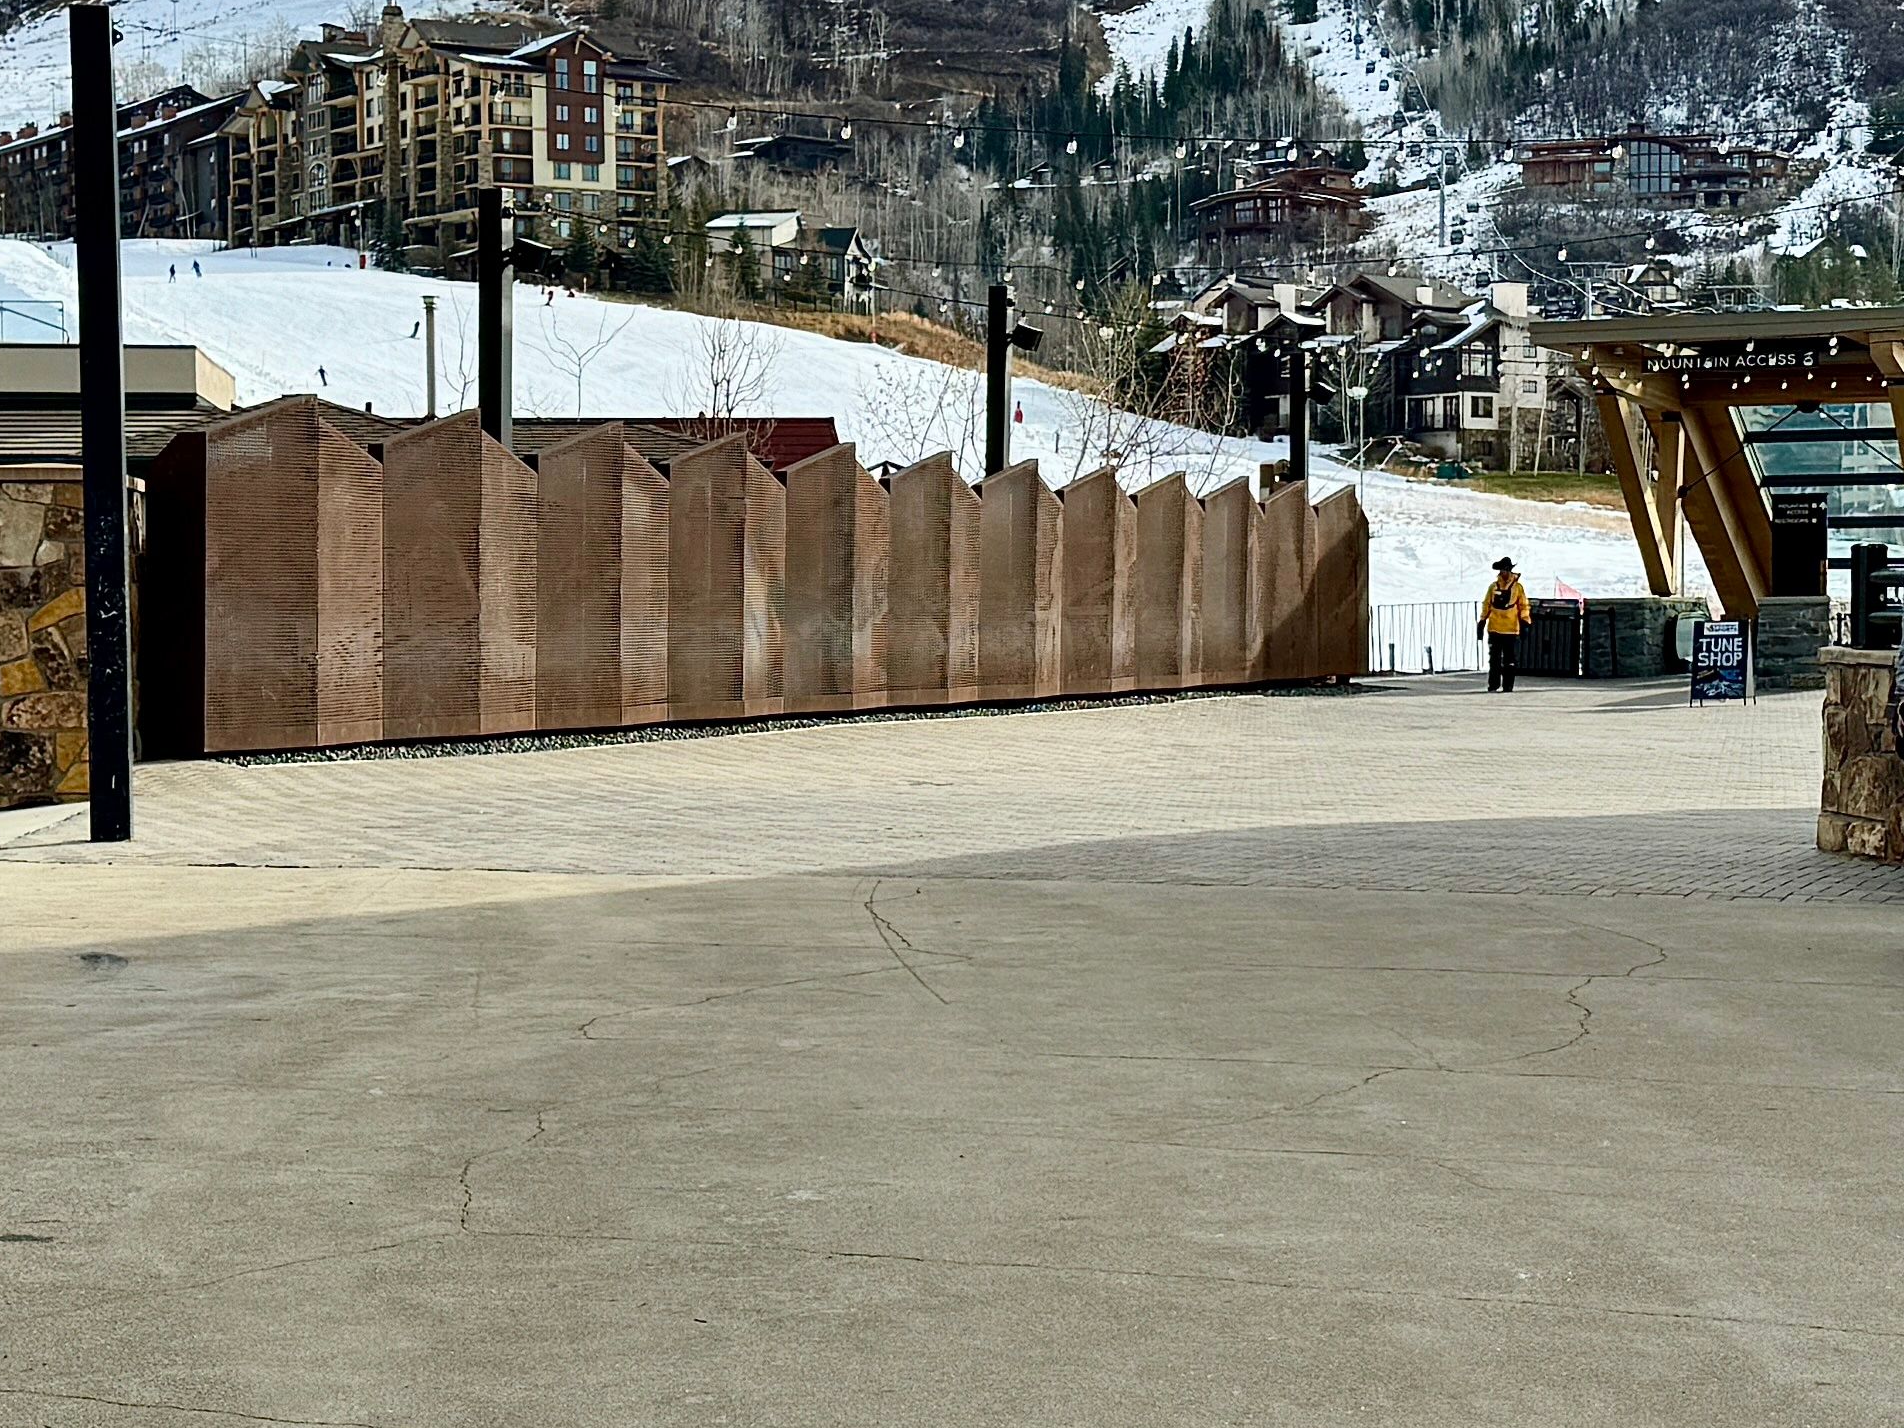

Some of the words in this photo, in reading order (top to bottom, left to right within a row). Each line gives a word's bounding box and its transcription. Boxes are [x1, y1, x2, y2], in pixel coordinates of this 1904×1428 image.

[1647, 357, 1729, 371] MOUNTIN
[1735, 353, 1796, 367] ACCSS
[1699, 637, 1743, 652] TUNE
[1697, 652, 1743, 666] SHOP
